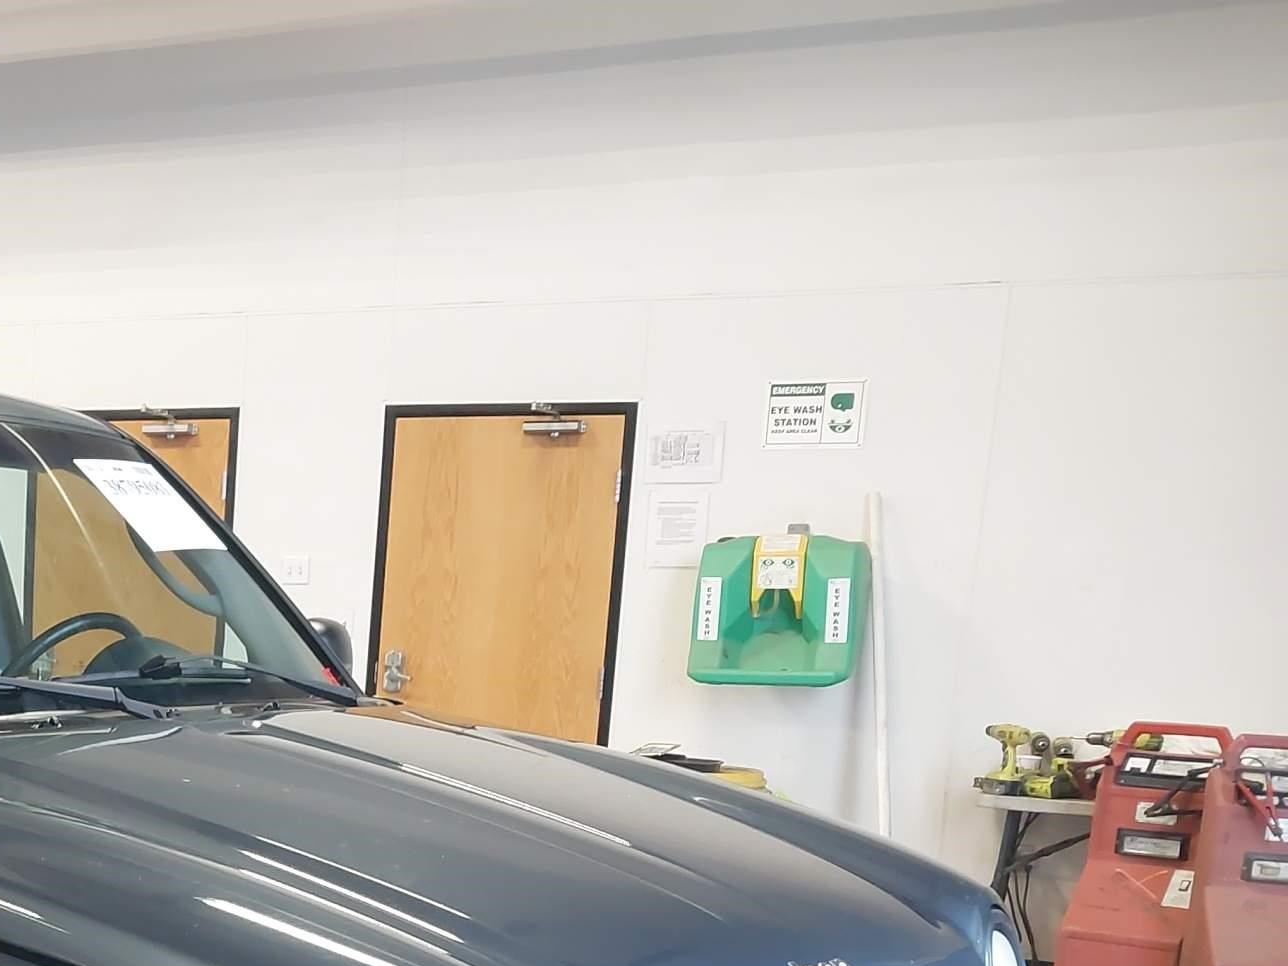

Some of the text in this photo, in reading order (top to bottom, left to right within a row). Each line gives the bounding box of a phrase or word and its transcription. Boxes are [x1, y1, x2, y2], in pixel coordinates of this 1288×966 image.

[772, 385, 825, 395] EMERGENCY
[771, 405, 823, 415] EYE WASH
[774, 418, 817, 427] STATION
[704, 609, 712, 636] WASH
[832, 611, 840, 638] WASH
